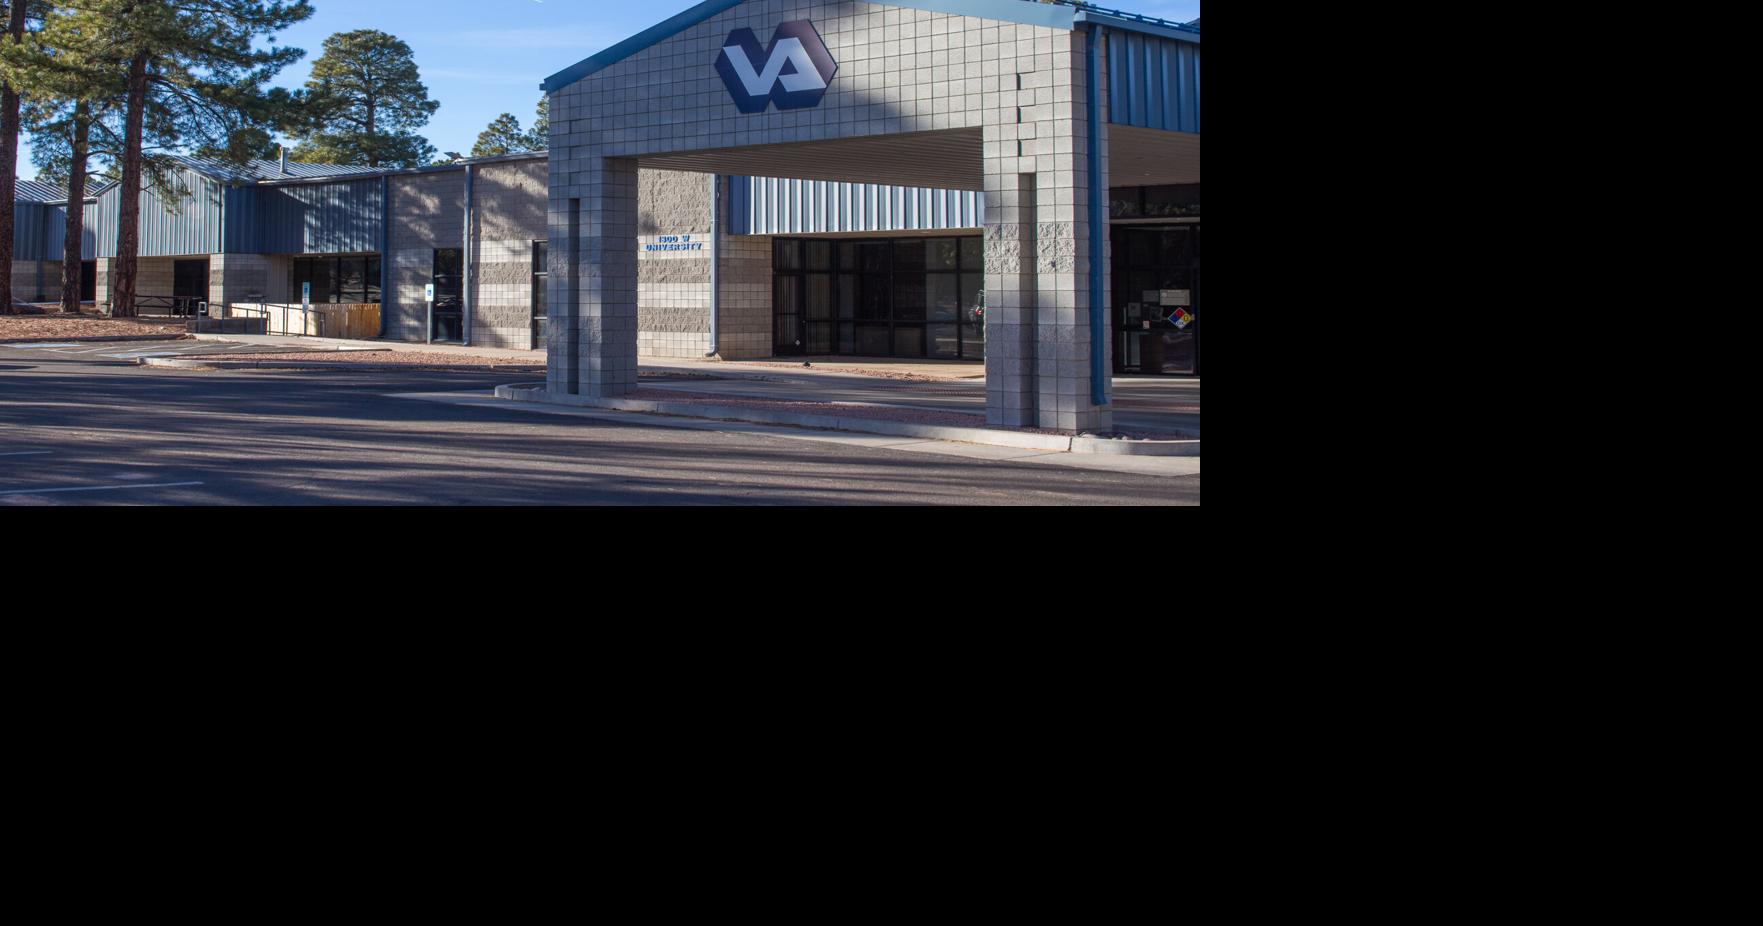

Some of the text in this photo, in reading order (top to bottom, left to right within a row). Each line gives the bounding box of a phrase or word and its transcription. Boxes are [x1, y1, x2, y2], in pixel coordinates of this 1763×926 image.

[722, 37, 827, 97] VA
[682, 234, 690, 242] W
[645, 243, 702, 251] UNIVERSITY
